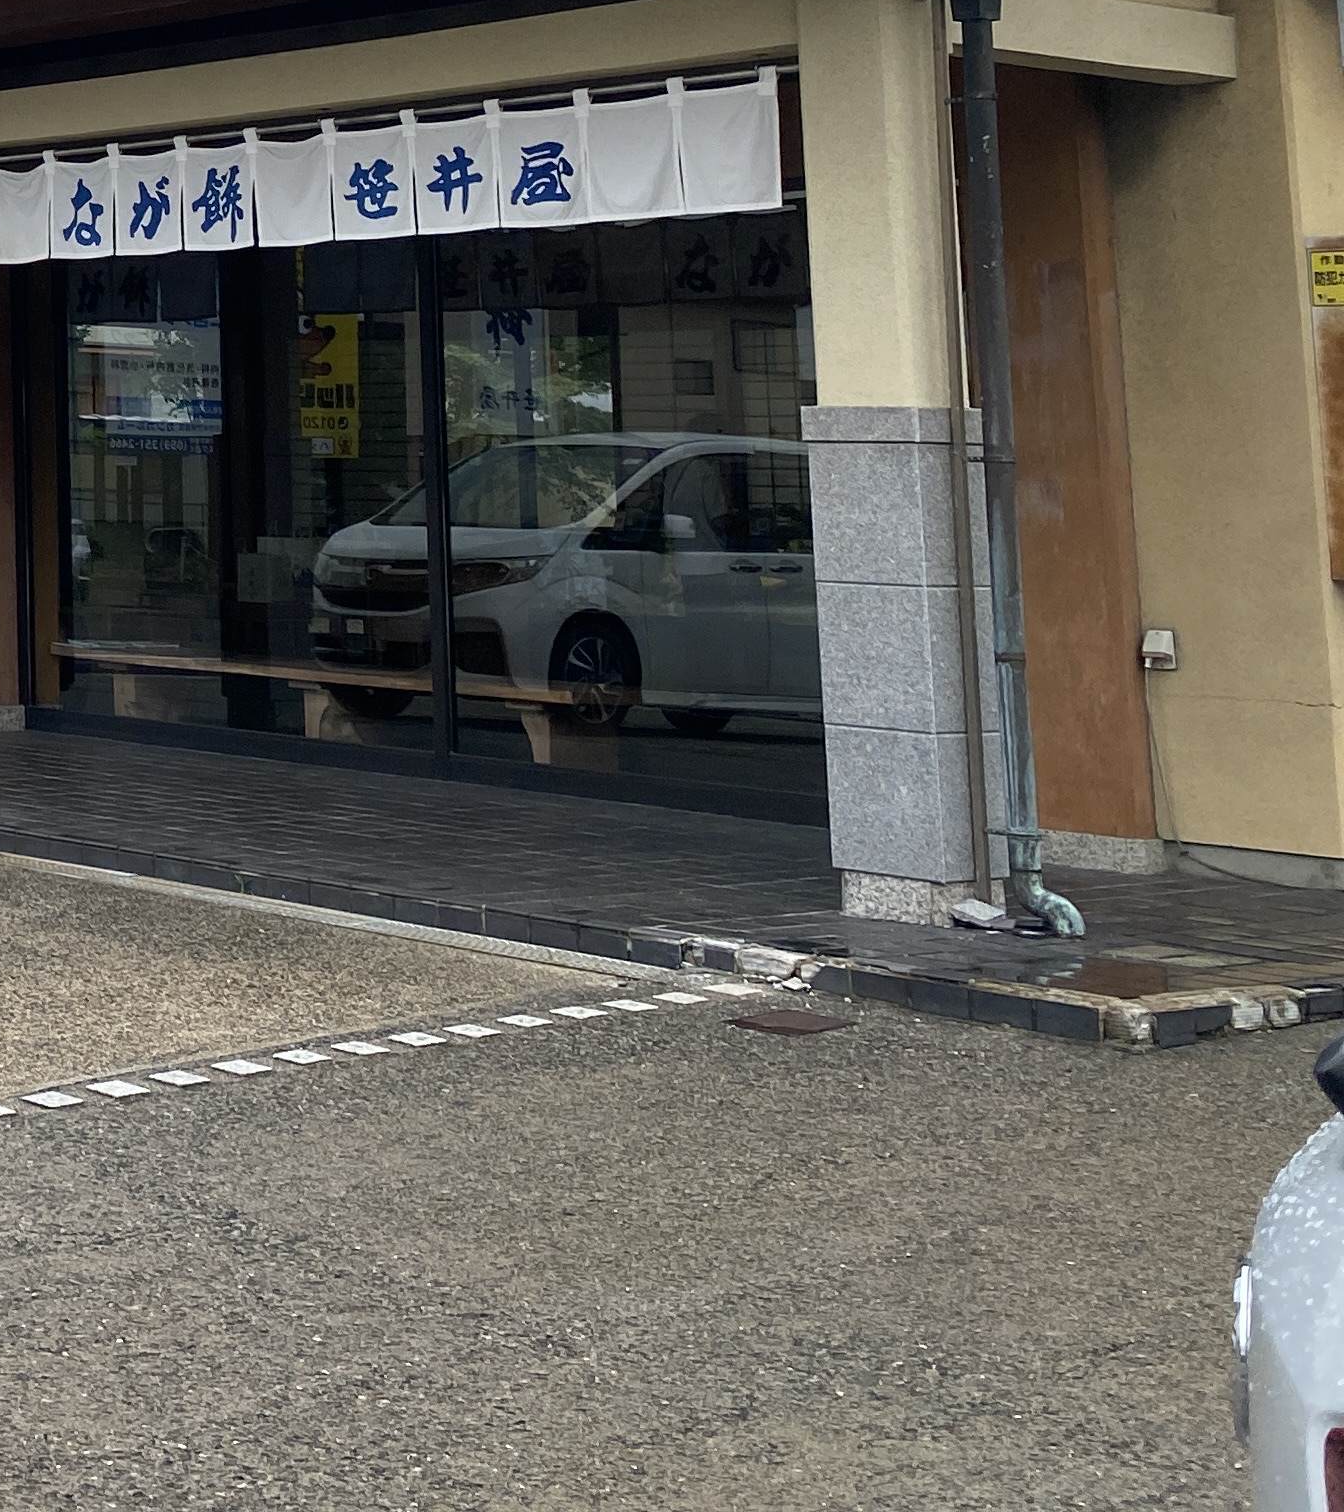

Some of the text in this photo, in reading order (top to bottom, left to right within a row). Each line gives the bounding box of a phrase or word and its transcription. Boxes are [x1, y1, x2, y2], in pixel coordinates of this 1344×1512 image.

[63, 165, 245, 247] なが餅
[344, 141, 574, 219] 笹井屋
